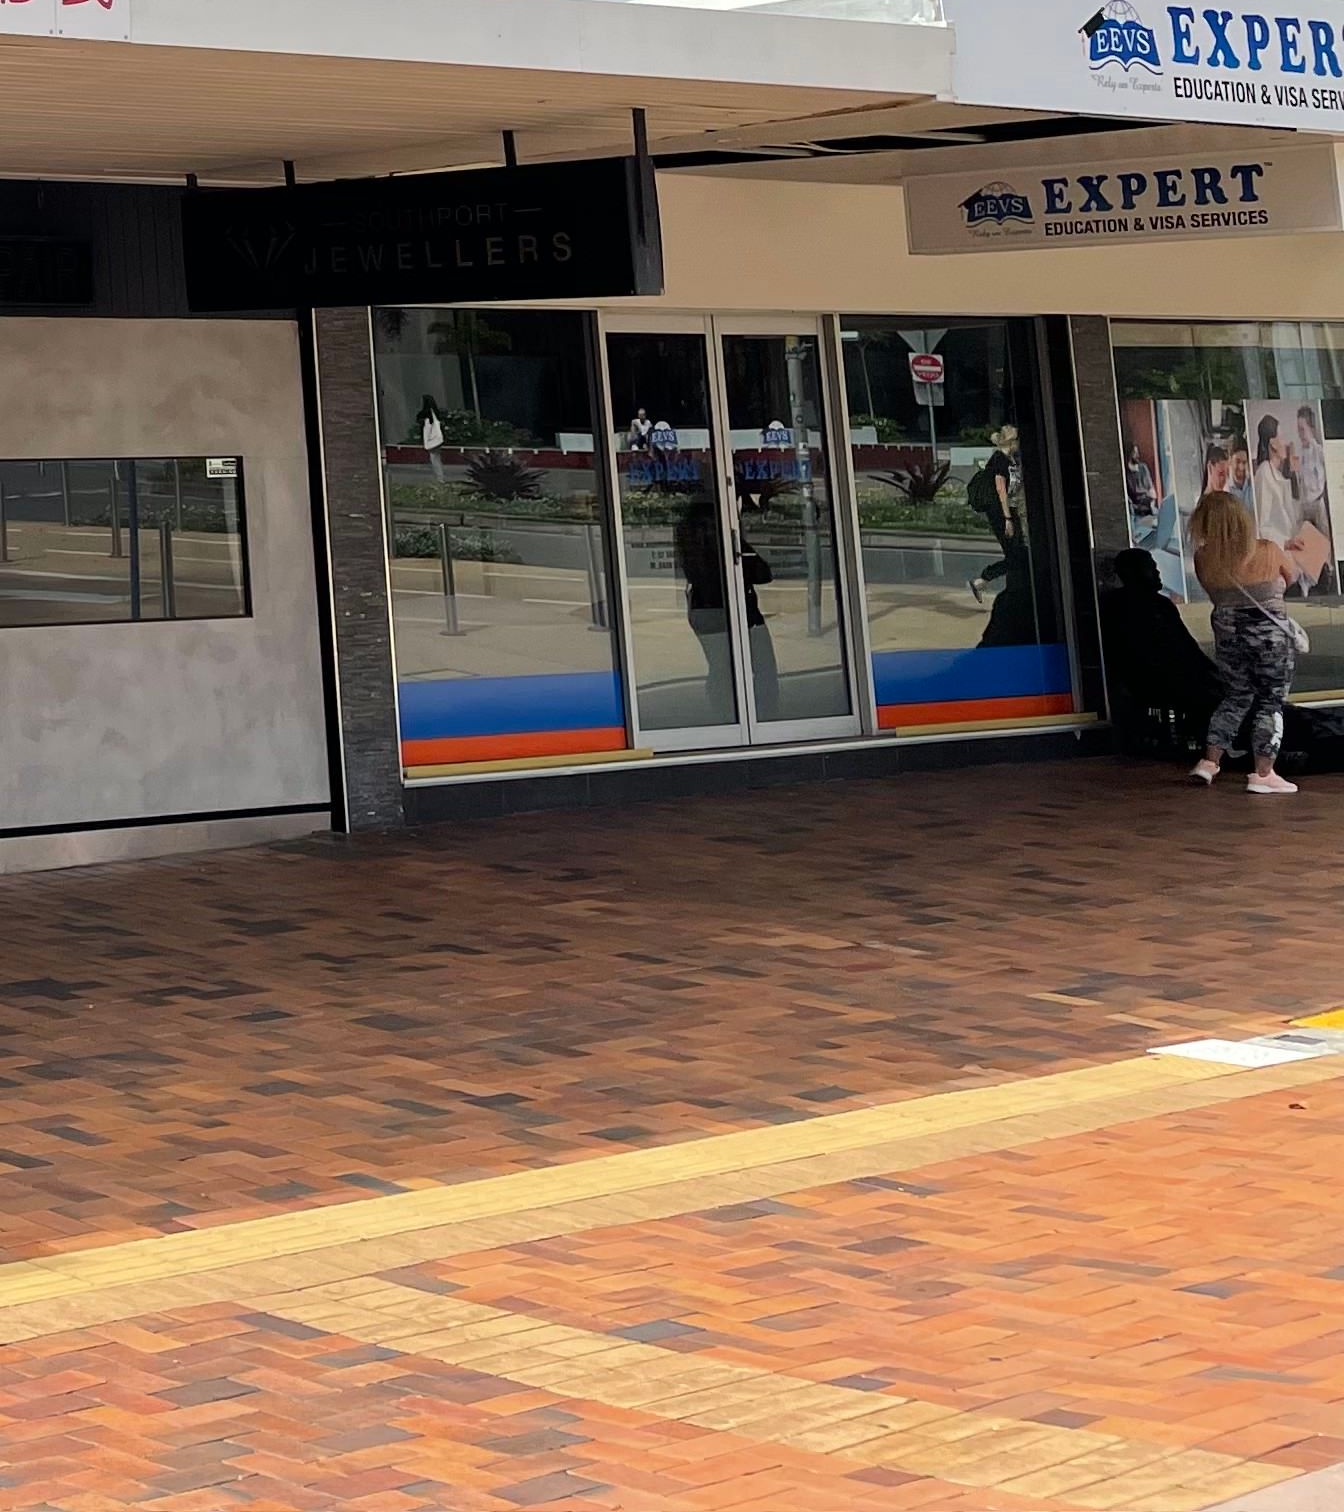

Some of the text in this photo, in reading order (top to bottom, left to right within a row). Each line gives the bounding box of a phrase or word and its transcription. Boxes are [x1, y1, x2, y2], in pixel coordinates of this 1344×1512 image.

[1096, 28, 1151, 55] EEVS
[1167, 6, 1344, 79] EXPER
[1173, 76, 1256, 104] EDUCATION
[1261, 87, 1271, 105] &
[1277, 85, 1308, 108] VISA
[1041, 164, 1263, 214] EXPERT
[353, 203, 509, 233] SOUTHPORT
[974, 197, 1023, 217] EEVS
[1045, 209, 1268, 236] EDUCATION & VISA SERVICES
[304, 231, 575, 275] JEWELLERS
